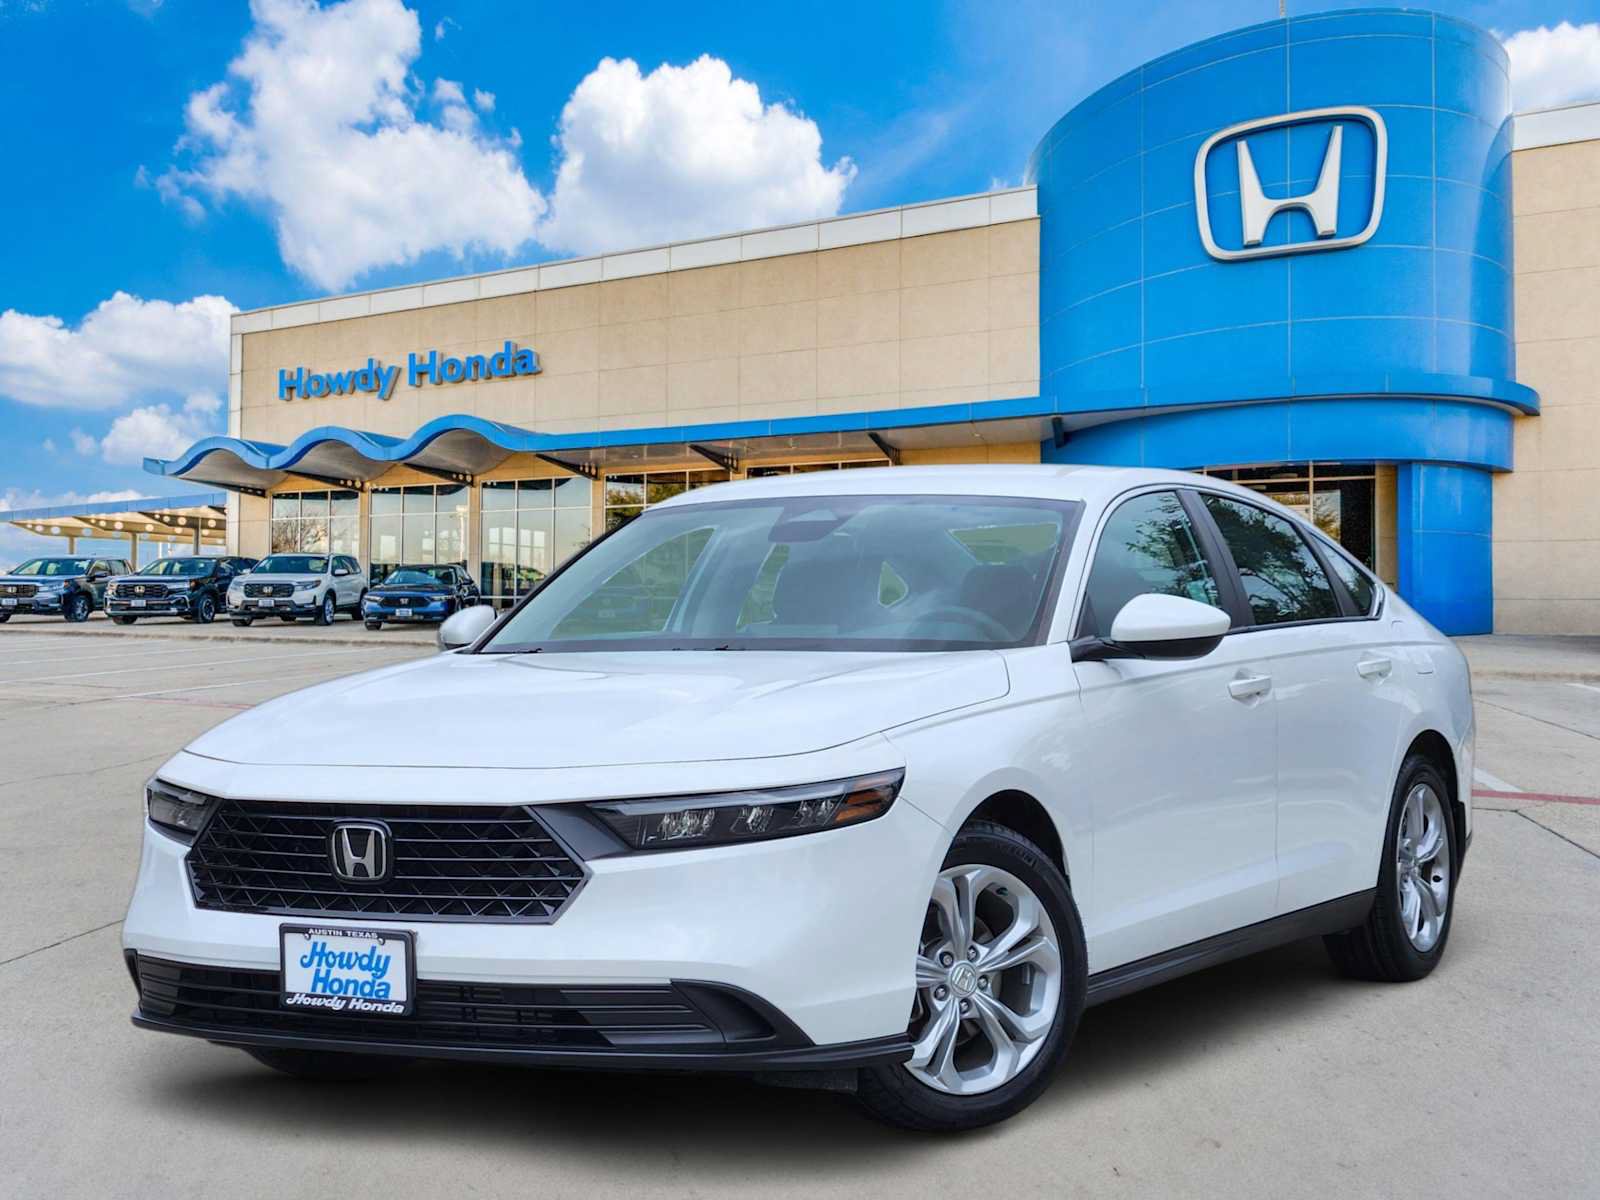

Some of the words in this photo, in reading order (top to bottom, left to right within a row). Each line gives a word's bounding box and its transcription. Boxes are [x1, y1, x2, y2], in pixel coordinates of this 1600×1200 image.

[278, 358, 402, 400] Howdy
[408, 340, 541, 387] Honda
[308, 928, 343, 937] AUSTIN
[345, 930, 379, 939] TEXAS
[300, 941, 391, 979] Howdy
[311, 968, 392, 999] Honda
[286, 993, 346, 1010] Howdy
[348, 998, 405, 1013] Honda
